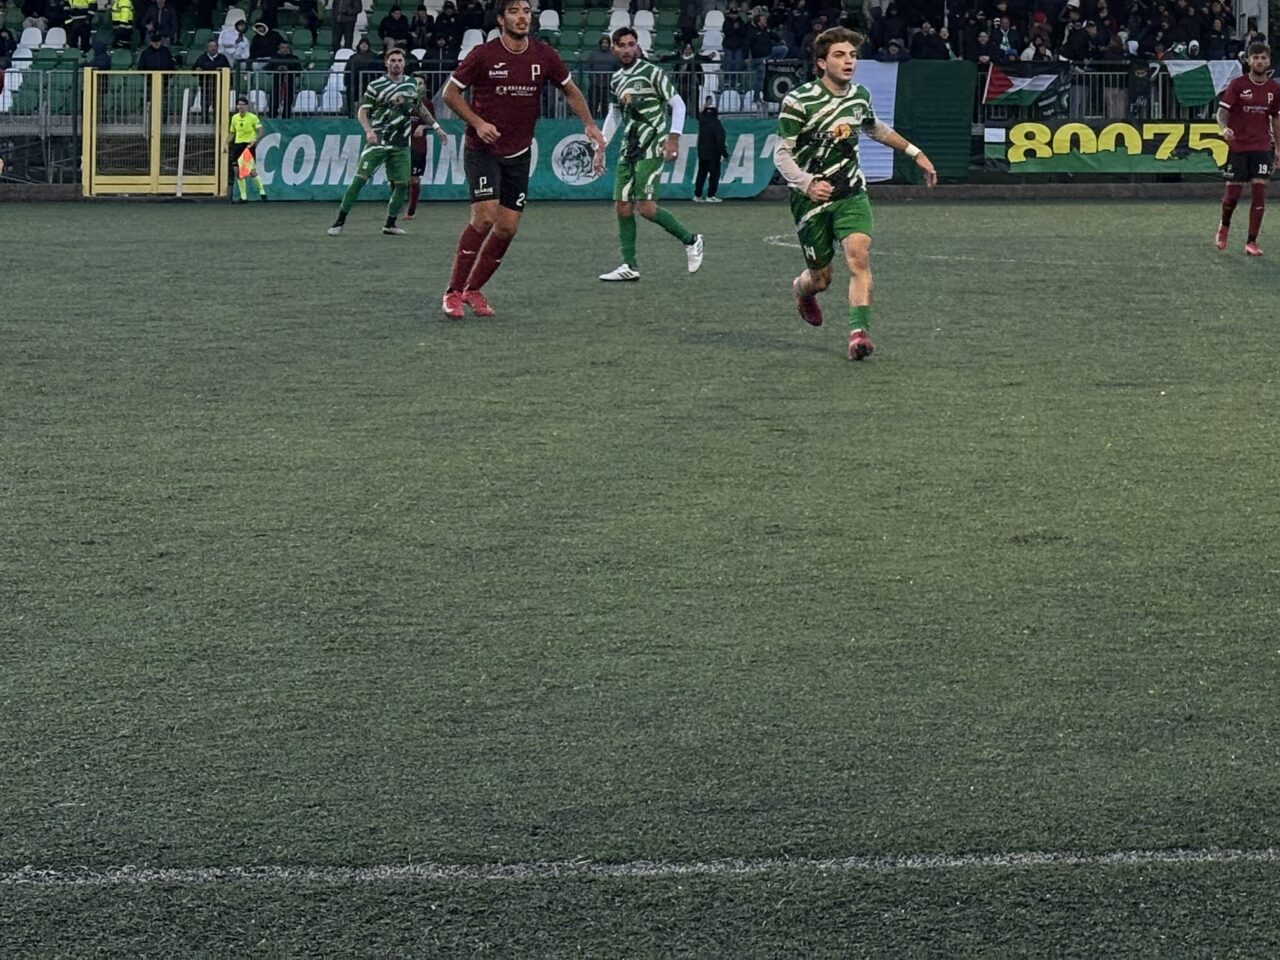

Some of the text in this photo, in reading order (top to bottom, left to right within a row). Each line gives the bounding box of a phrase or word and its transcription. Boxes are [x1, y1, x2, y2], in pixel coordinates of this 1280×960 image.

[255, 132, 539, 186] COMN
[1007, 122, 1230, 167] 80075
[1258, 164, 1268, 174] 19
